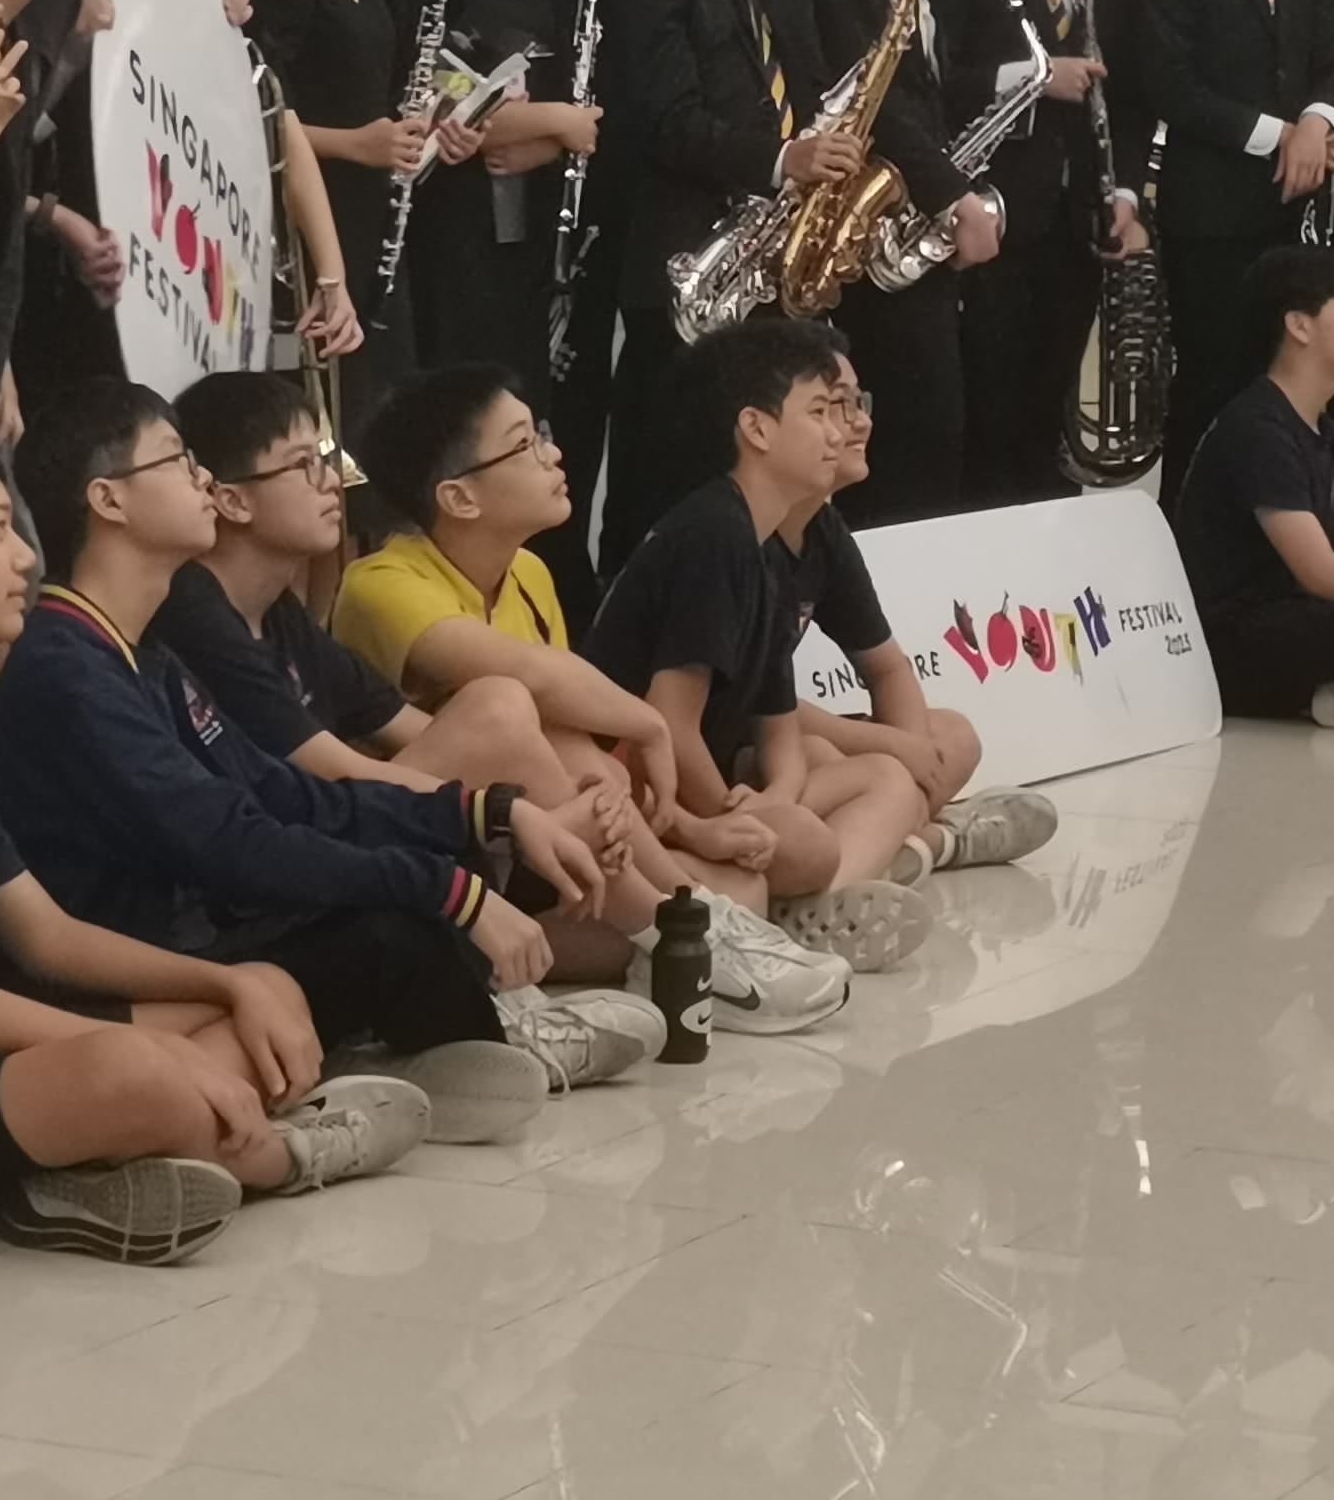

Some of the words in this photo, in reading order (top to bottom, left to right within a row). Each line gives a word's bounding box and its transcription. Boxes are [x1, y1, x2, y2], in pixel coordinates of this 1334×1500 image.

[129, 49, 261, 284] SINGAPORE
[943, 585, 1112, 686] YOUTH
[1118, 601, 1183, 633] FESTIVAL
